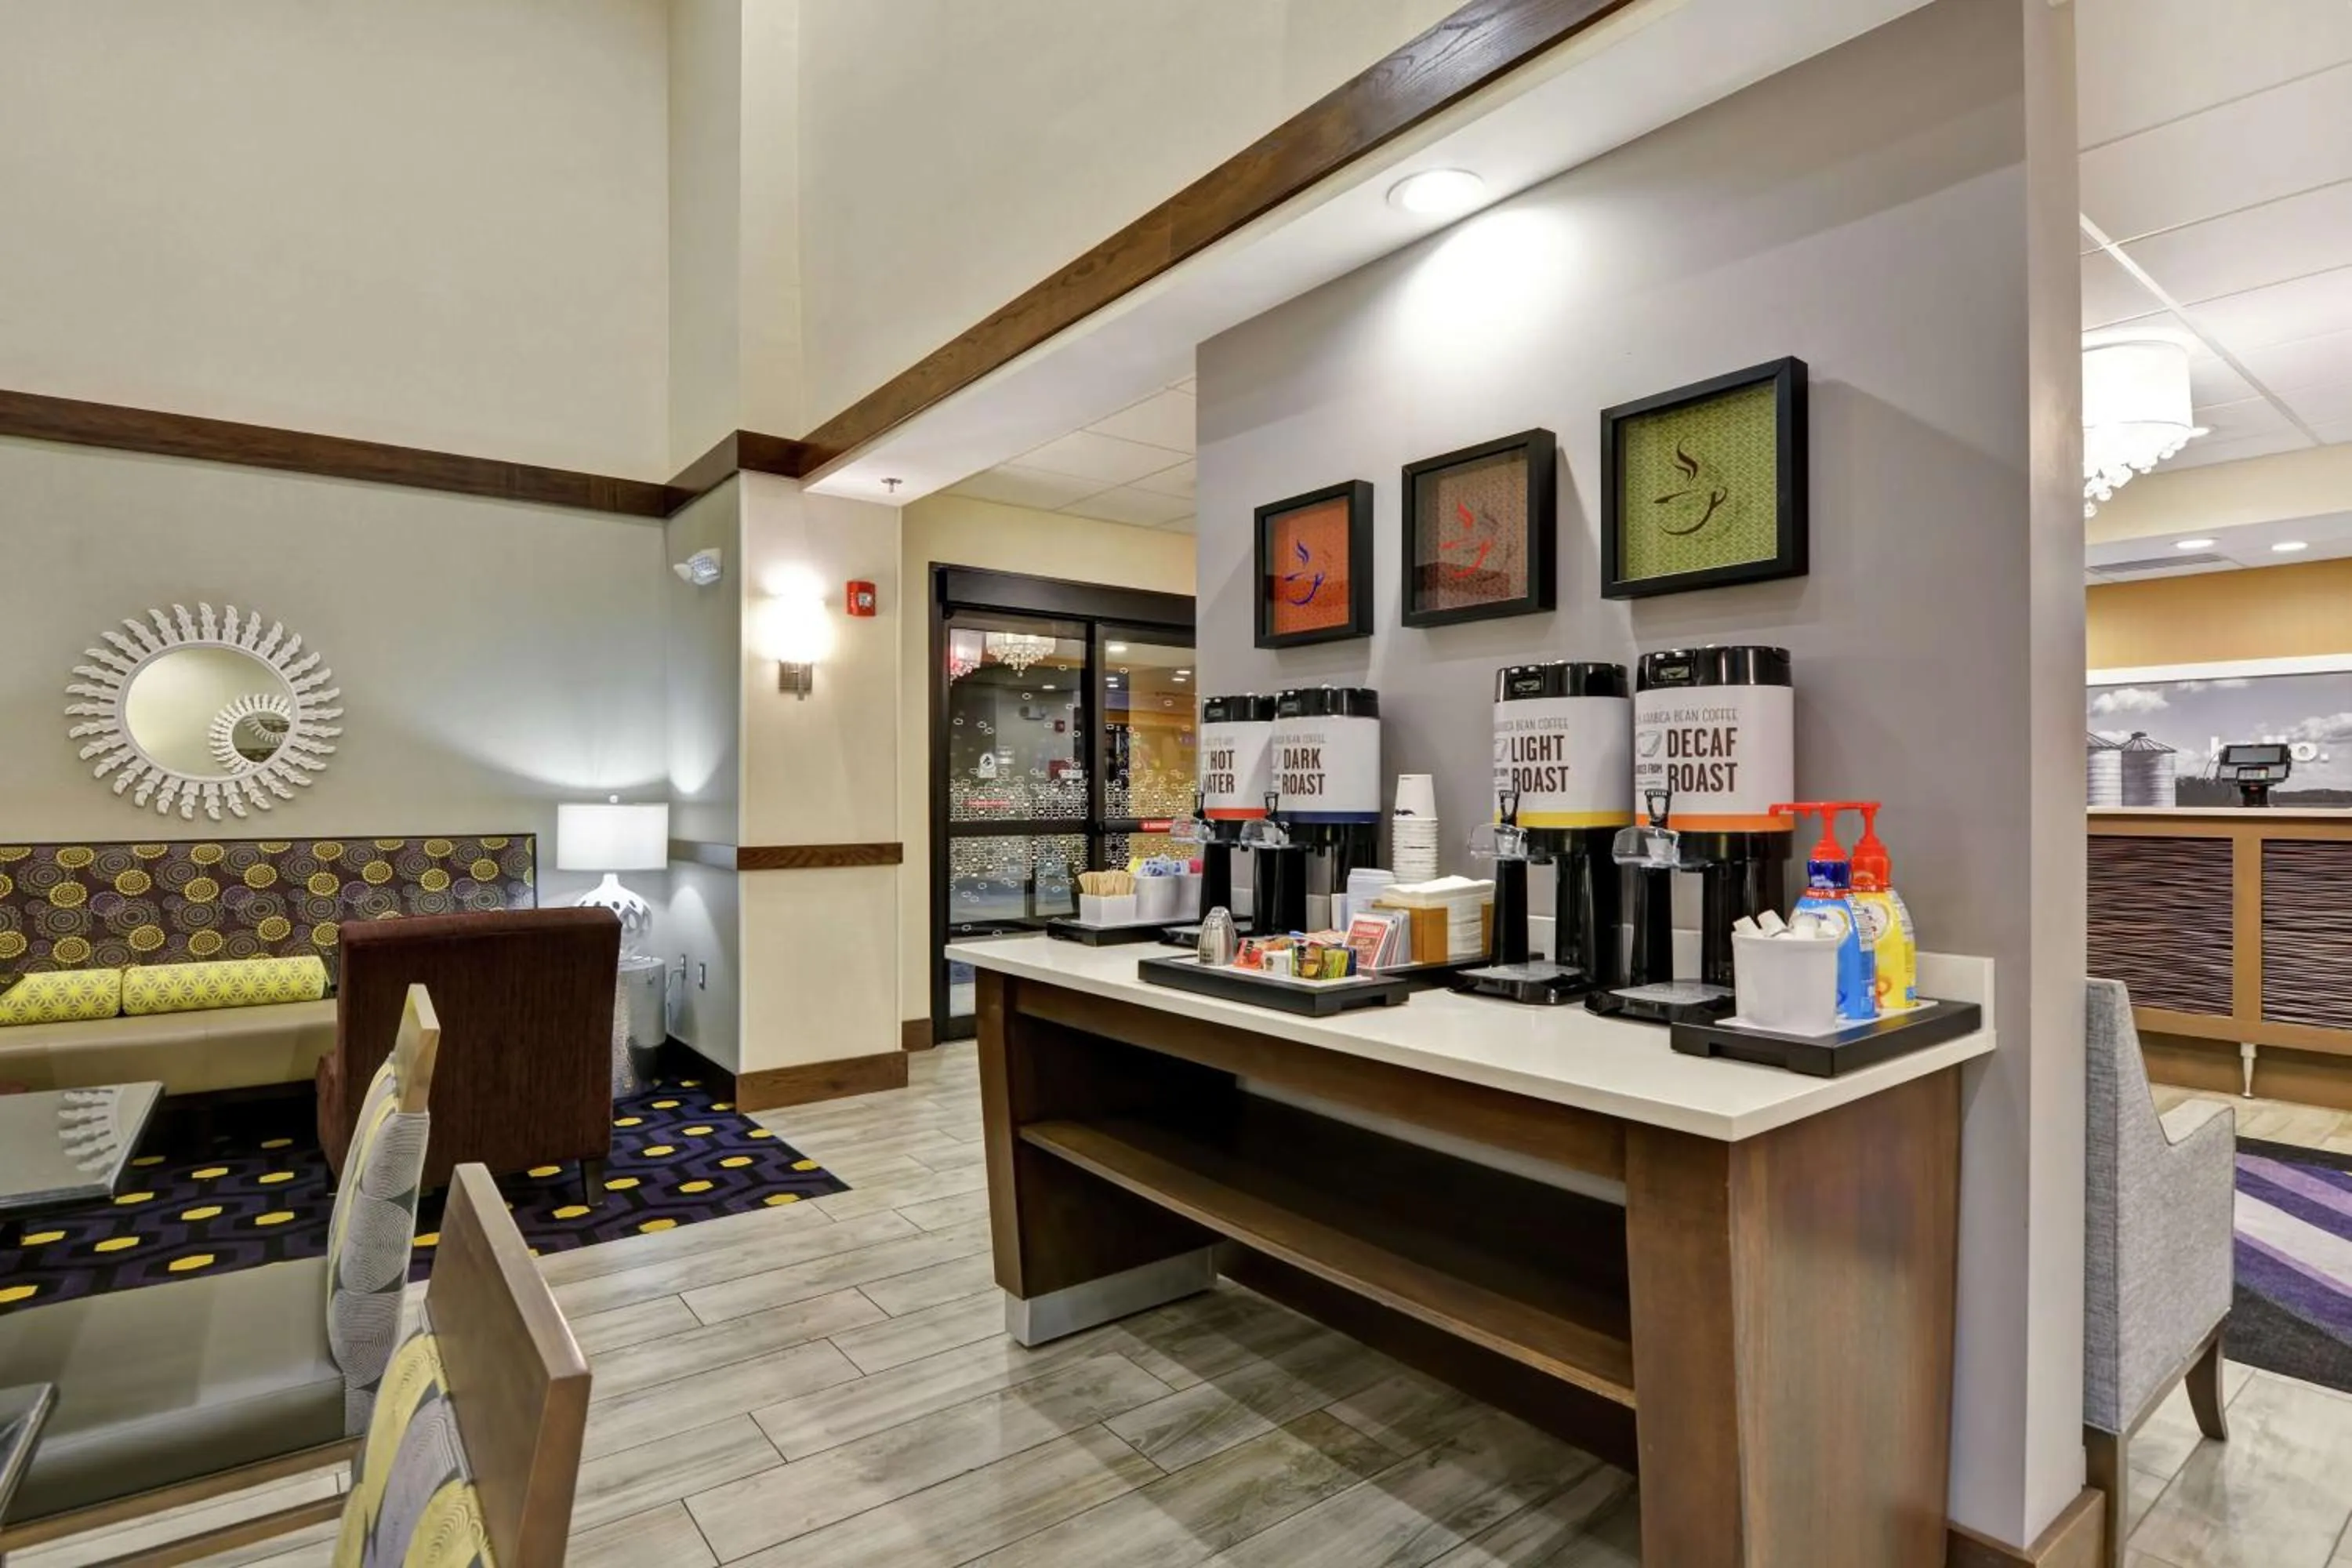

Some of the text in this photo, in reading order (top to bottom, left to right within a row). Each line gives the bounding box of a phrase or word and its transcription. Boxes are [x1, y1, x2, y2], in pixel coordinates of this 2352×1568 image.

[1702, 707, 1738, 722] COFFEE
[1511, 735, 1565, 763] LIGHT
[1667, 727, 1738, 757] DECAF
[1210, 750, 1235, 770] HOT
[1283, 748, 1320, 770] DARK
[1282, 773, 1326, 795] ROAST
[1512, 766, 1569, 793] ROAST
[1668, 762, 1738, 793] ROAST
